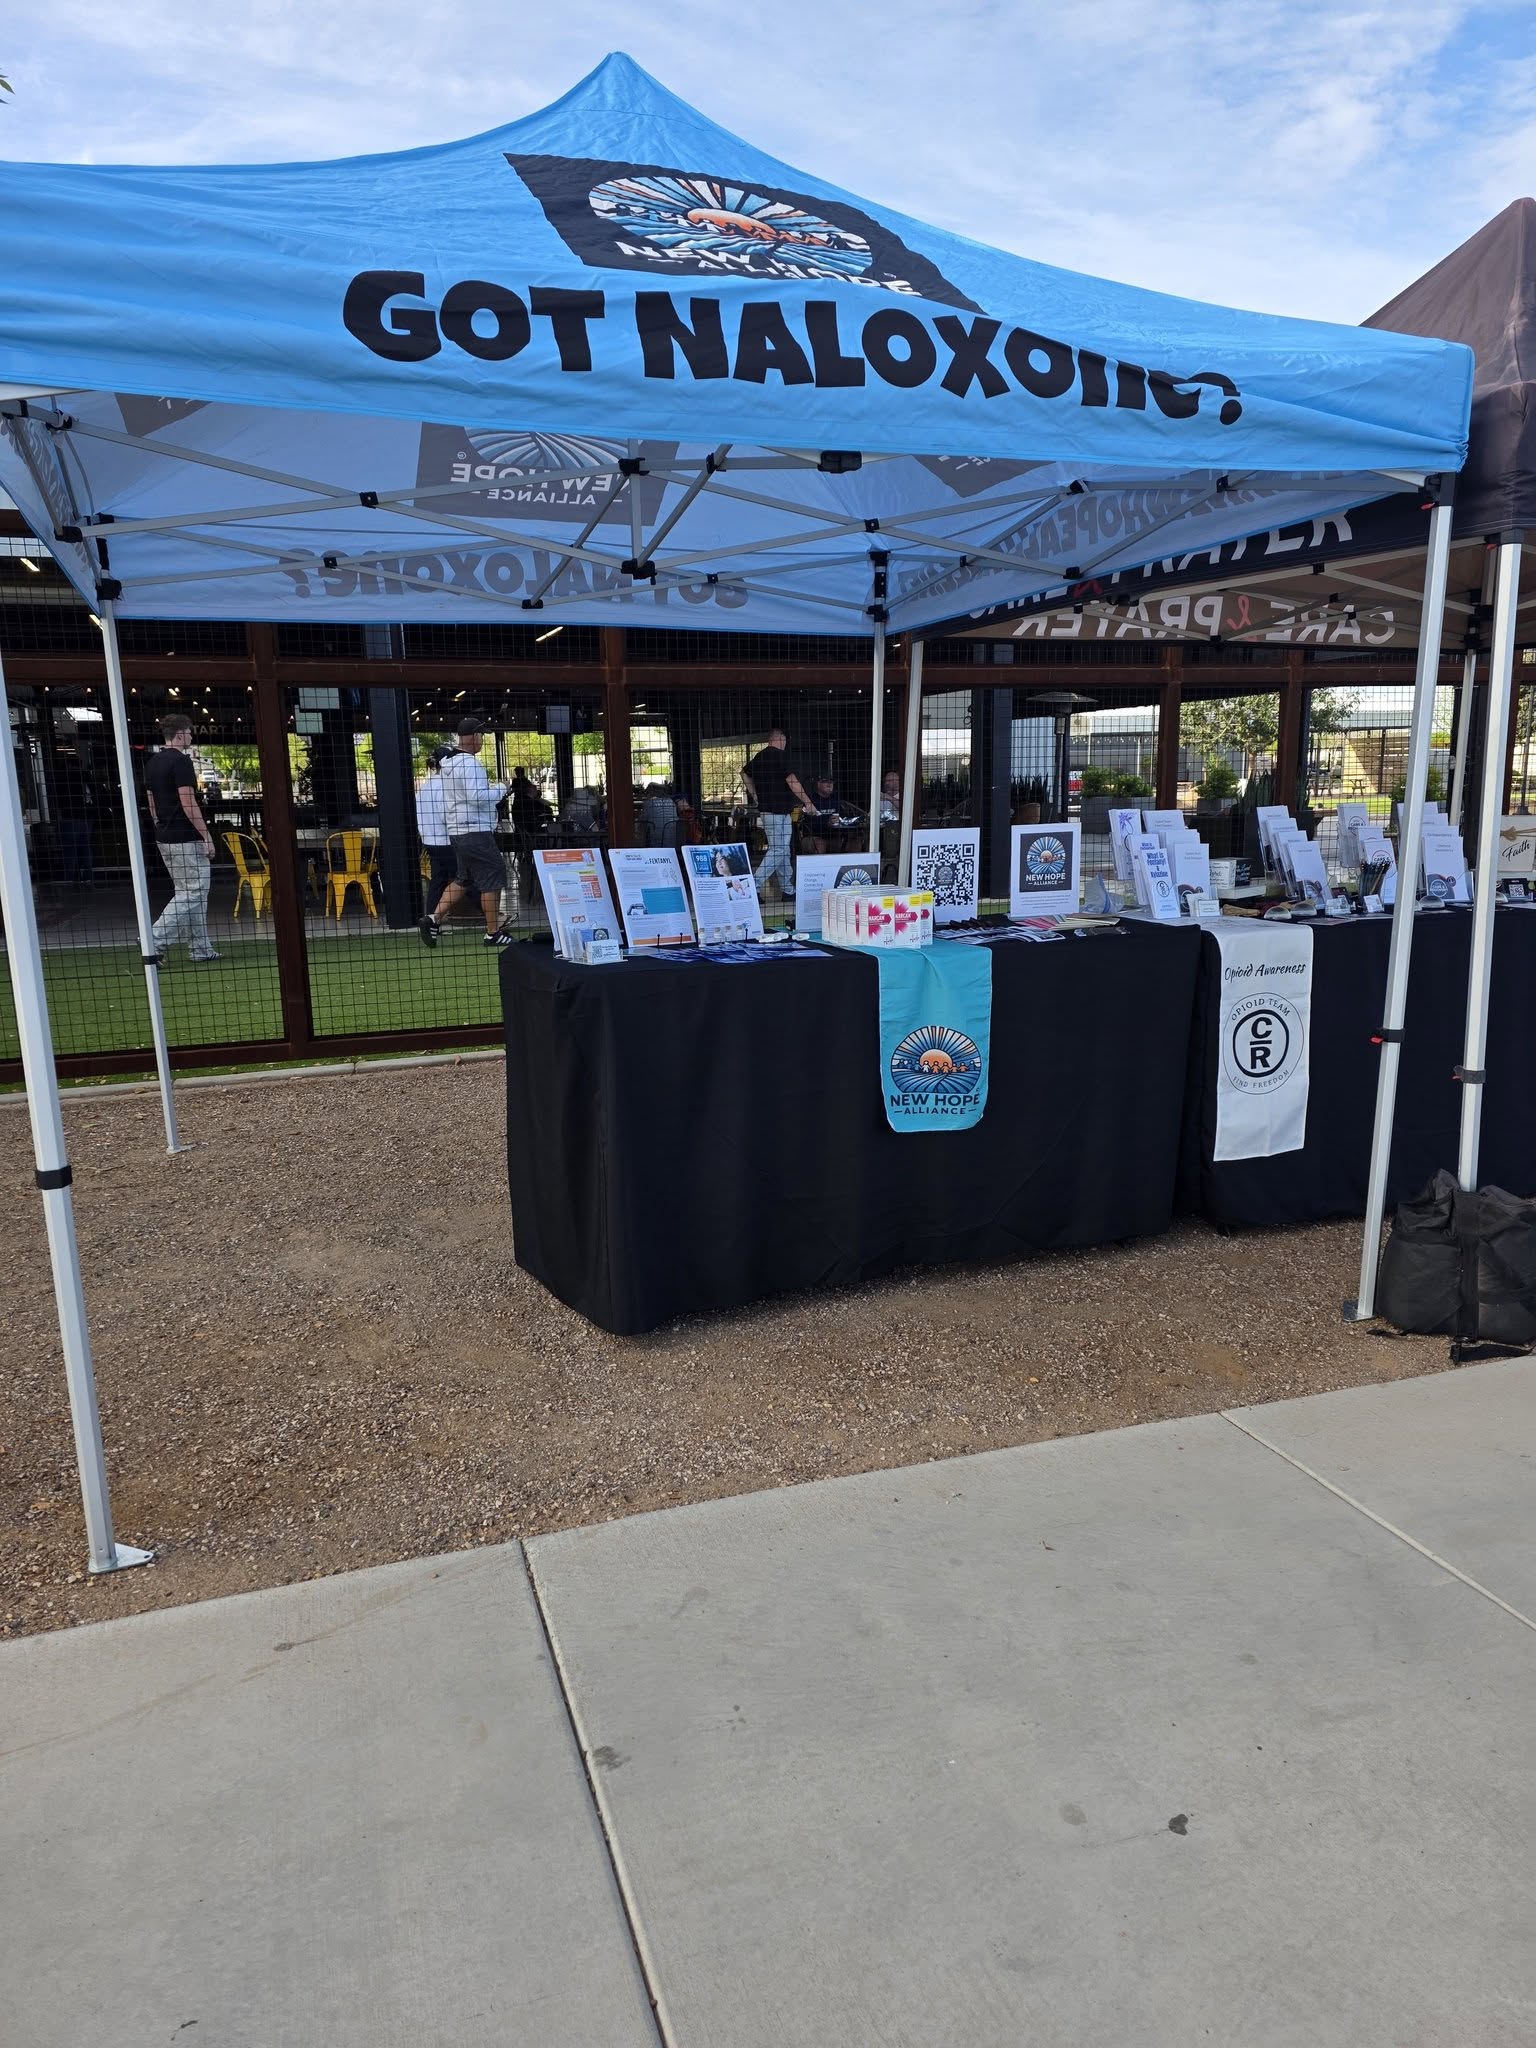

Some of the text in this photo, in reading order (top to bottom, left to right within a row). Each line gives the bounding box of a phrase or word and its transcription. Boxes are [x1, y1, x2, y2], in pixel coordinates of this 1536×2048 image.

[614, 240, 751, 264] NEW
[342, 270, 606, 372] GOT
[1502, 840, 1531, 862] Faith
[895, 912, 911, 920] NARCAN
[1224, 963, 1306, 983] Opioid Awareness
[1231, 997, 1291, 1021] OPIOID TEAM
[1232, 1069, 1290, 1089] FIND FREEDOM
[889, 1093, 980, 1107] NEW HOPE
[903, 1107, 967, 1115] ALLIANCE
